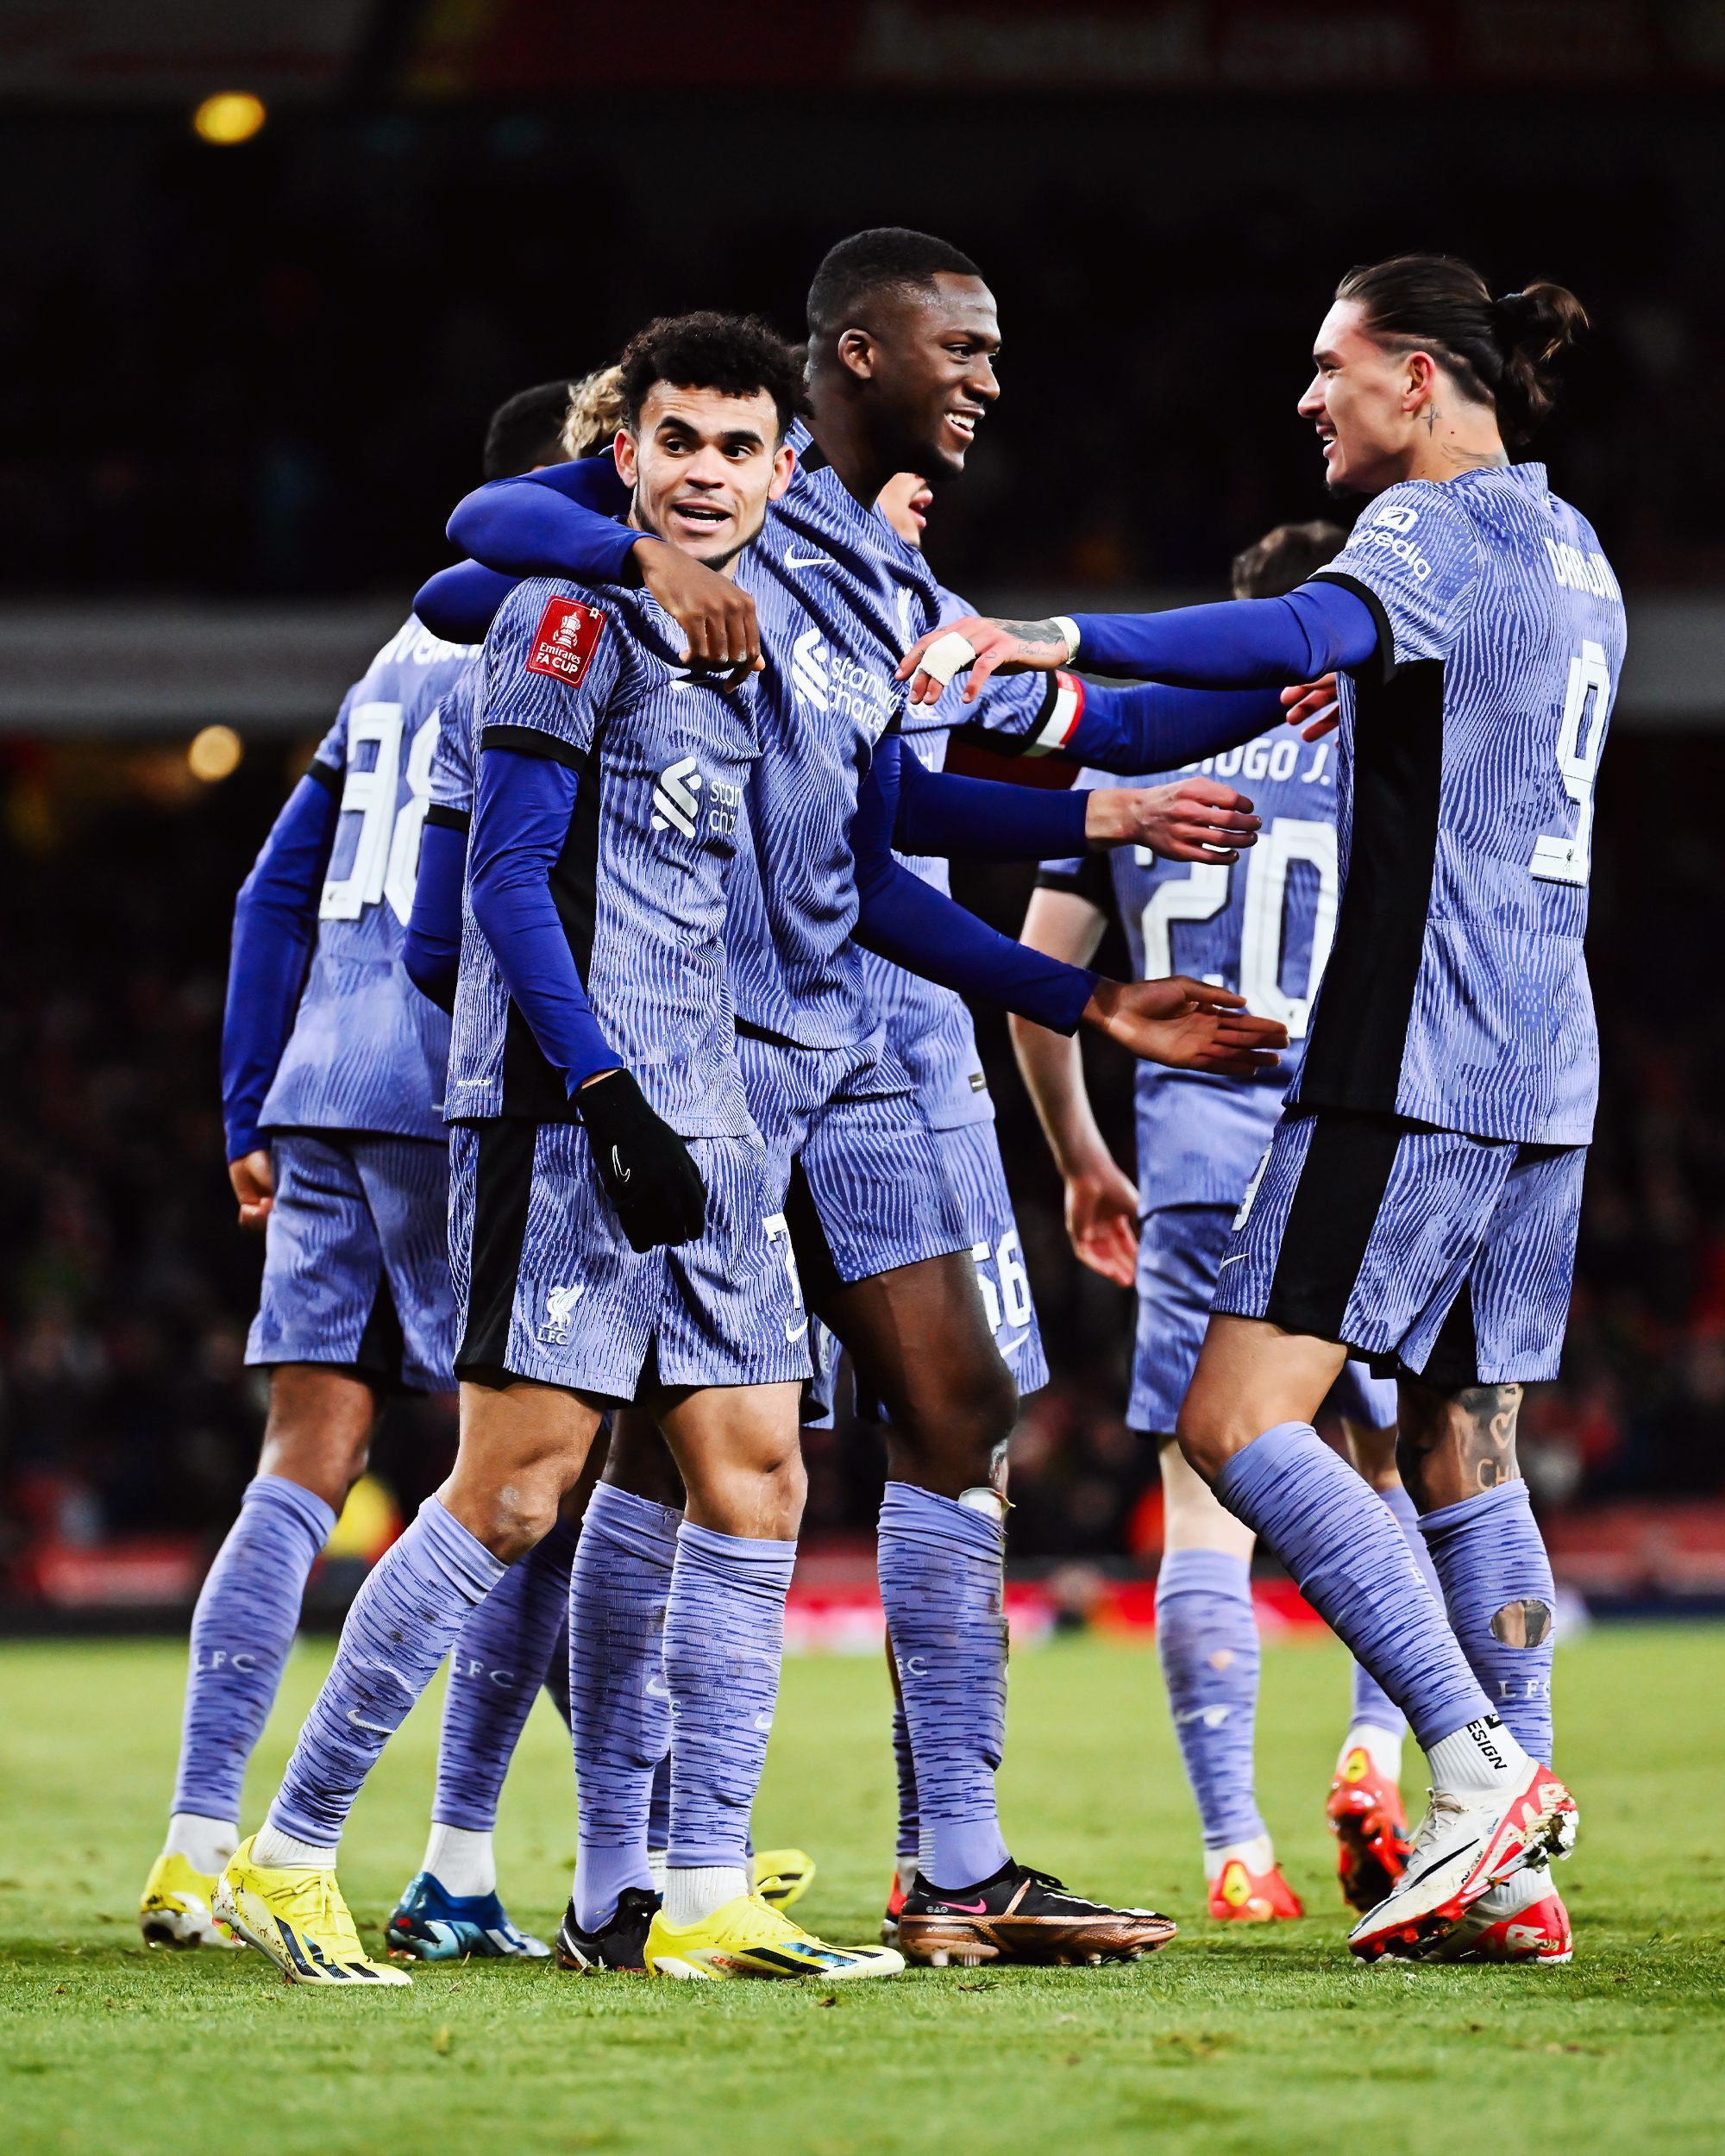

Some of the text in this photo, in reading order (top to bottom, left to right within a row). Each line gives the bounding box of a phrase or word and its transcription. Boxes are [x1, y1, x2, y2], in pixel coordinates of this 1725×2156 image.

[1346, 530, 1432, 582] pedia
[535, 653, 579, 674] FA CUP
[539, 642, 581, 665] Emirates
[1176, 737, 1332, 786] OGO J.
[1529, 639, 1610, 881] 9
[895, 1656, 928, 1678] FC
[1466, 1719, 1509, 1770] ESIGN
